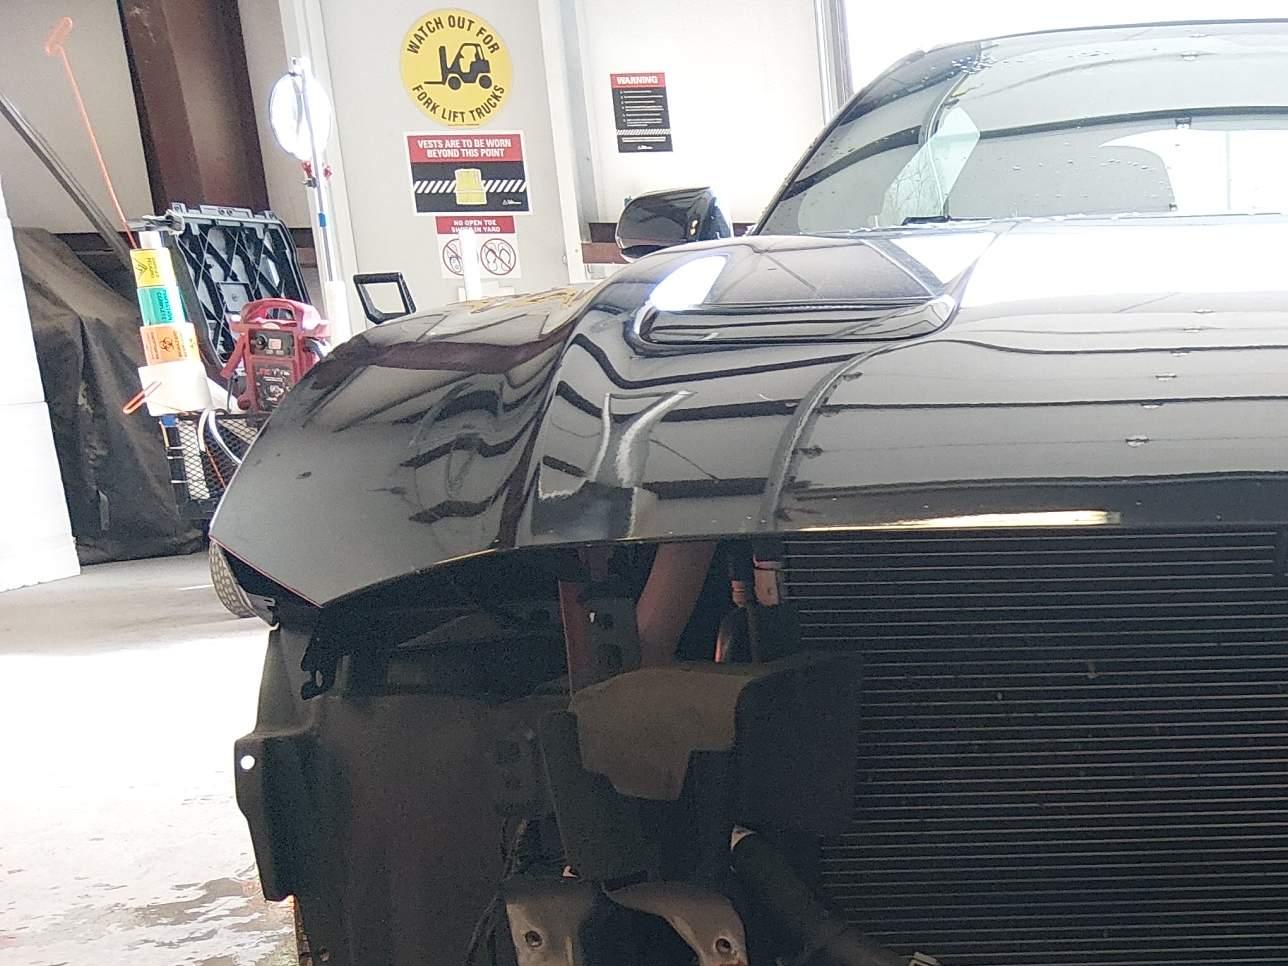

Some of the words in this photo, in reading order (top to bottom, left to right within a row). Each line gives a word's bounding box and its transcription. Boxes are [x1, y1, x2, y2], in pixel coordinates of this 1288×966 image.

[406, 16, 444, 54] WATCH
[448, 15, 474, 31] OUT
[476, 27, 500, 54] FOR
[616, 76, 658, 84] WARNING
[412, 84, 440, 114] FORK
[442, 108, 466, 122] LIFT
[469, 85, 504, 121] TRUCKS
[418, 140, 443, 148] VESTS
[445, 140, 460, 148] ARE
[462, 140, 472, 148] TO
[474, 139, 484, 147] BE
[485, 139, 512, 148] WORN
[427, 149, 459, 158] BEYOND
[461, 149, 479, 157] THIS
[480, 148, 504, 157] POINT
